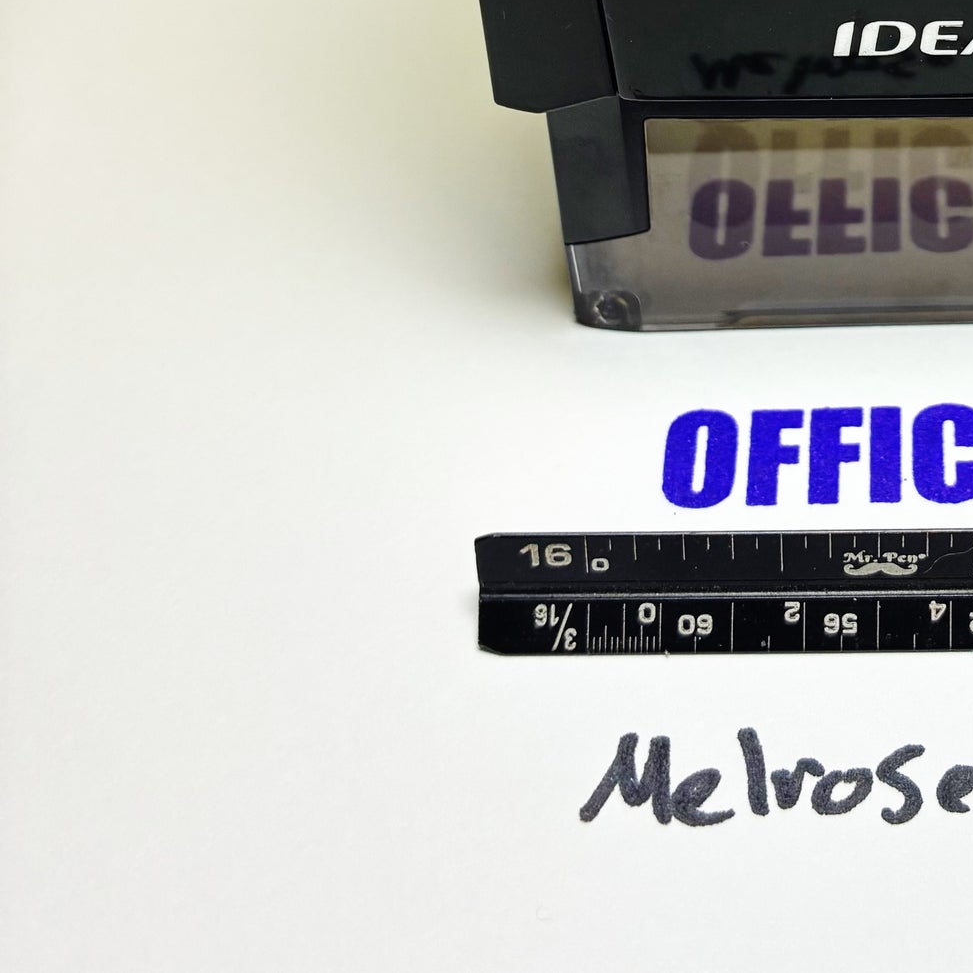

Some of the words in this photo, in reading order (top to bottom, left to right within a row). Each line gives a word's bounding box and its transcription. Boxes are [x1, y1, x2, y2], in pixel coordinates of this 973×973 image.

[519, 543, 573, 567] 16
[843, 550, 878, 563] Mr.
[637, 602, 657, 624] 0
[783, 601, 801, 623] 2
[928, 600, 947, 622] 4
[677, 613, 714, 636] 60
[823, 612, 858, 635] 56
